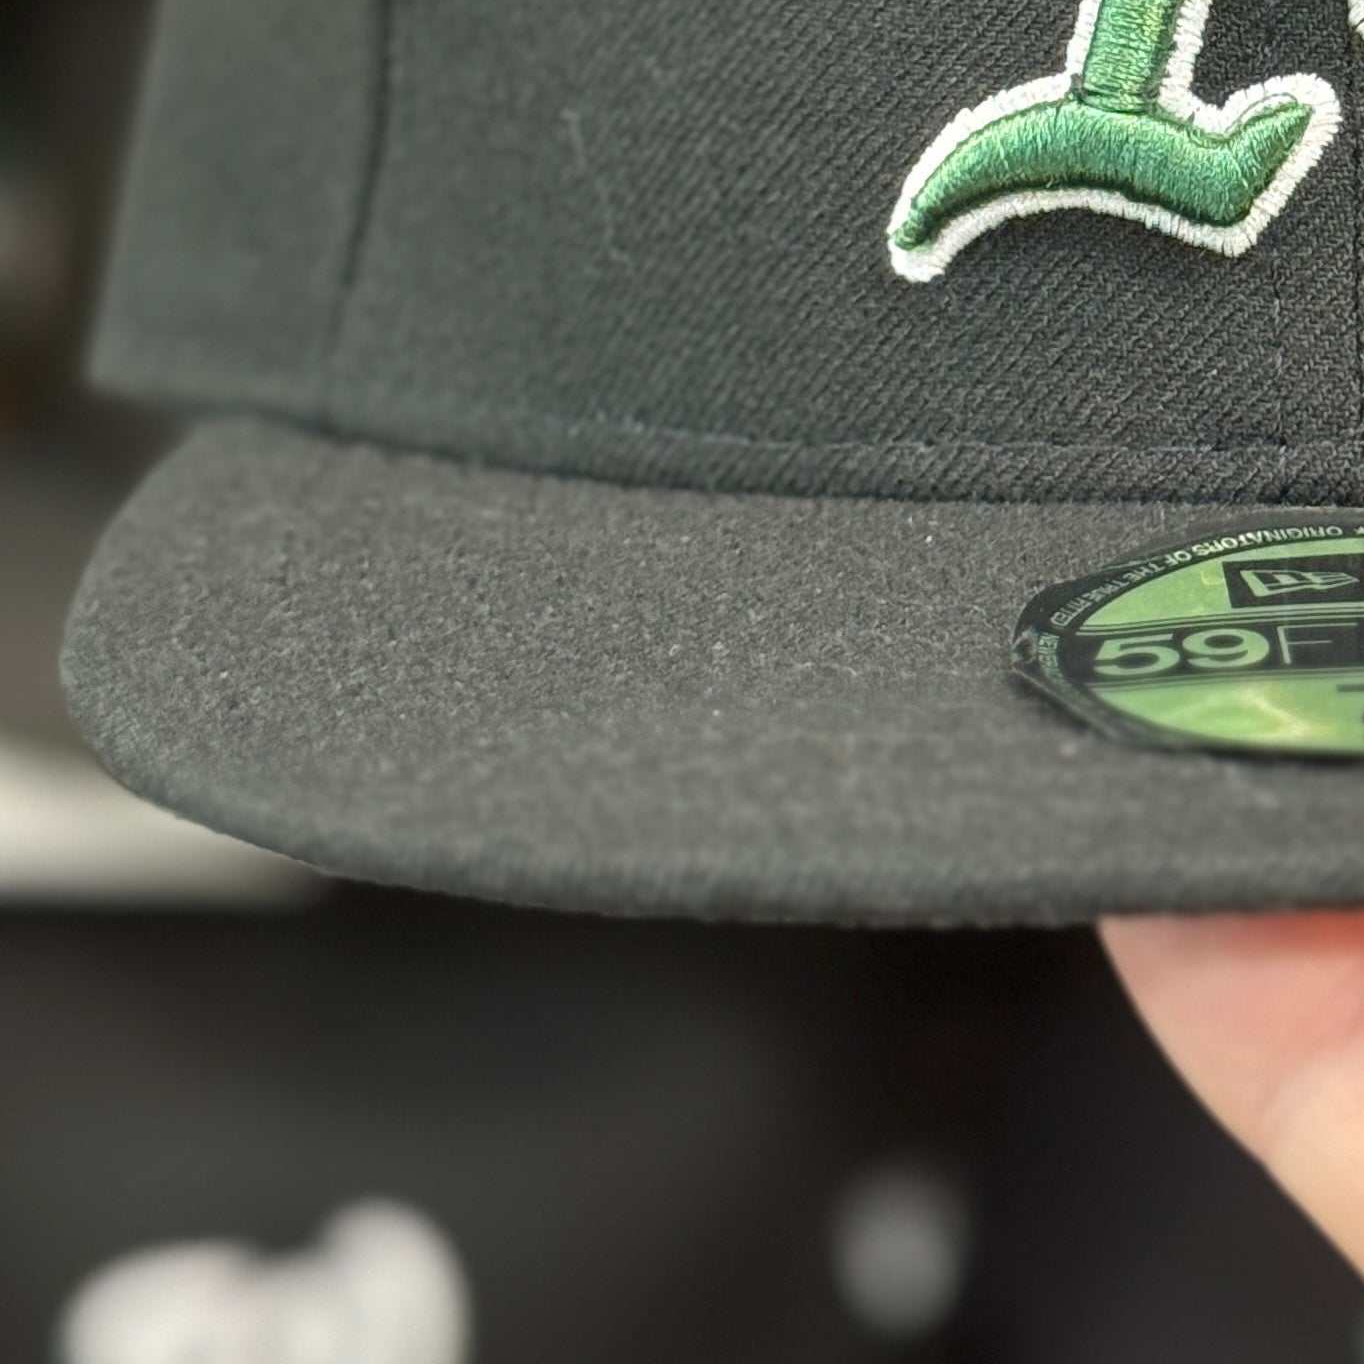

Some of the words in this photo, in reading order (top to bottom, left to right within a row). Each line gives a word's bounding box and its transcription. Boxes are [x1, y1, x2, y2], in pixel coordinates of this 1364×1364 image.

[1191, 525, 1343, 556] ORIGINATORS
[1163, 550, 1192, 563] OF
[1122, 562, 1165, 582] THE
[1081, 578, 1130, 602] TRUE
